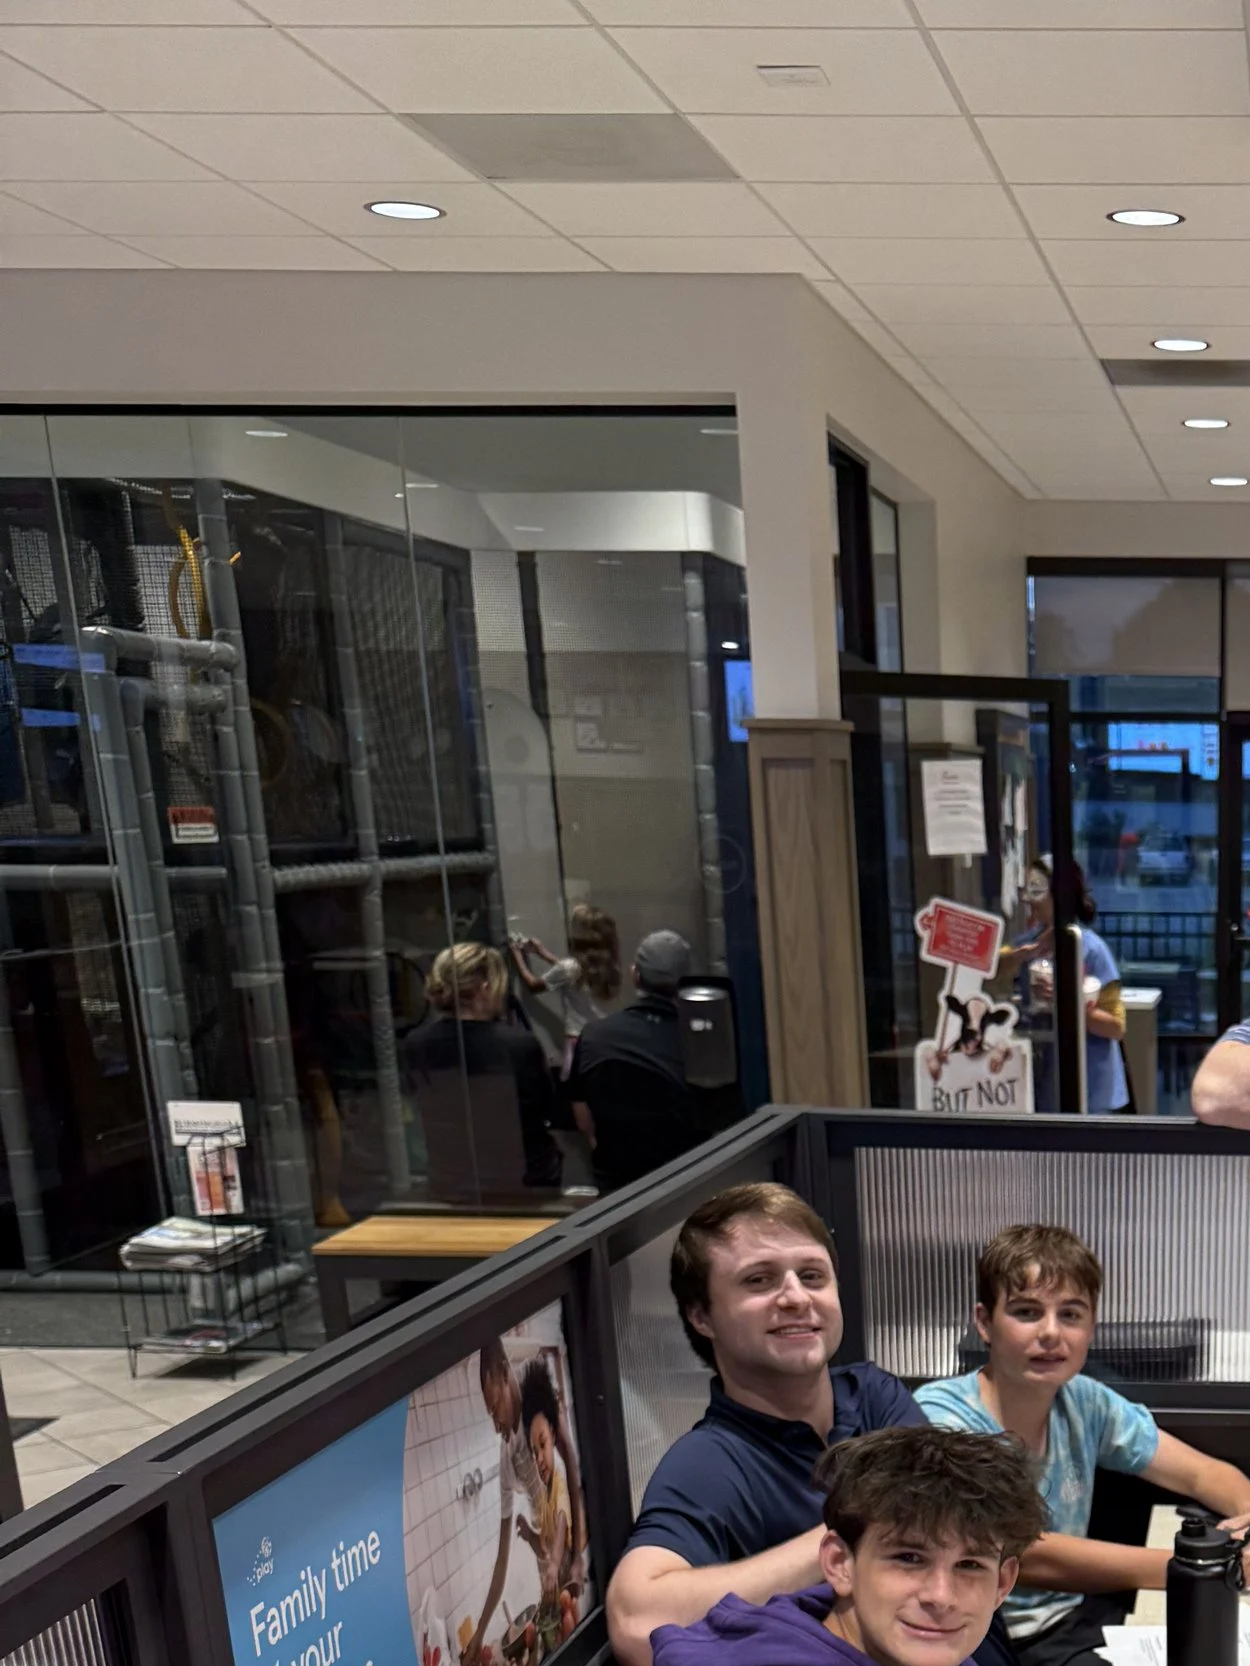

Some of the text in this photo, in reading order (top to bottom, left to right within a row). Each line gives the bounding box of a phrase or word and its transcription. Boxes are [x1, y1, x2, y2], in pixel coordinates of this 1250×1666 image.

[977, 1079, 1019, 1107] NOT
[256, 1558, 275, 1583] play
[250, 1530, 381, 1657] Family time
